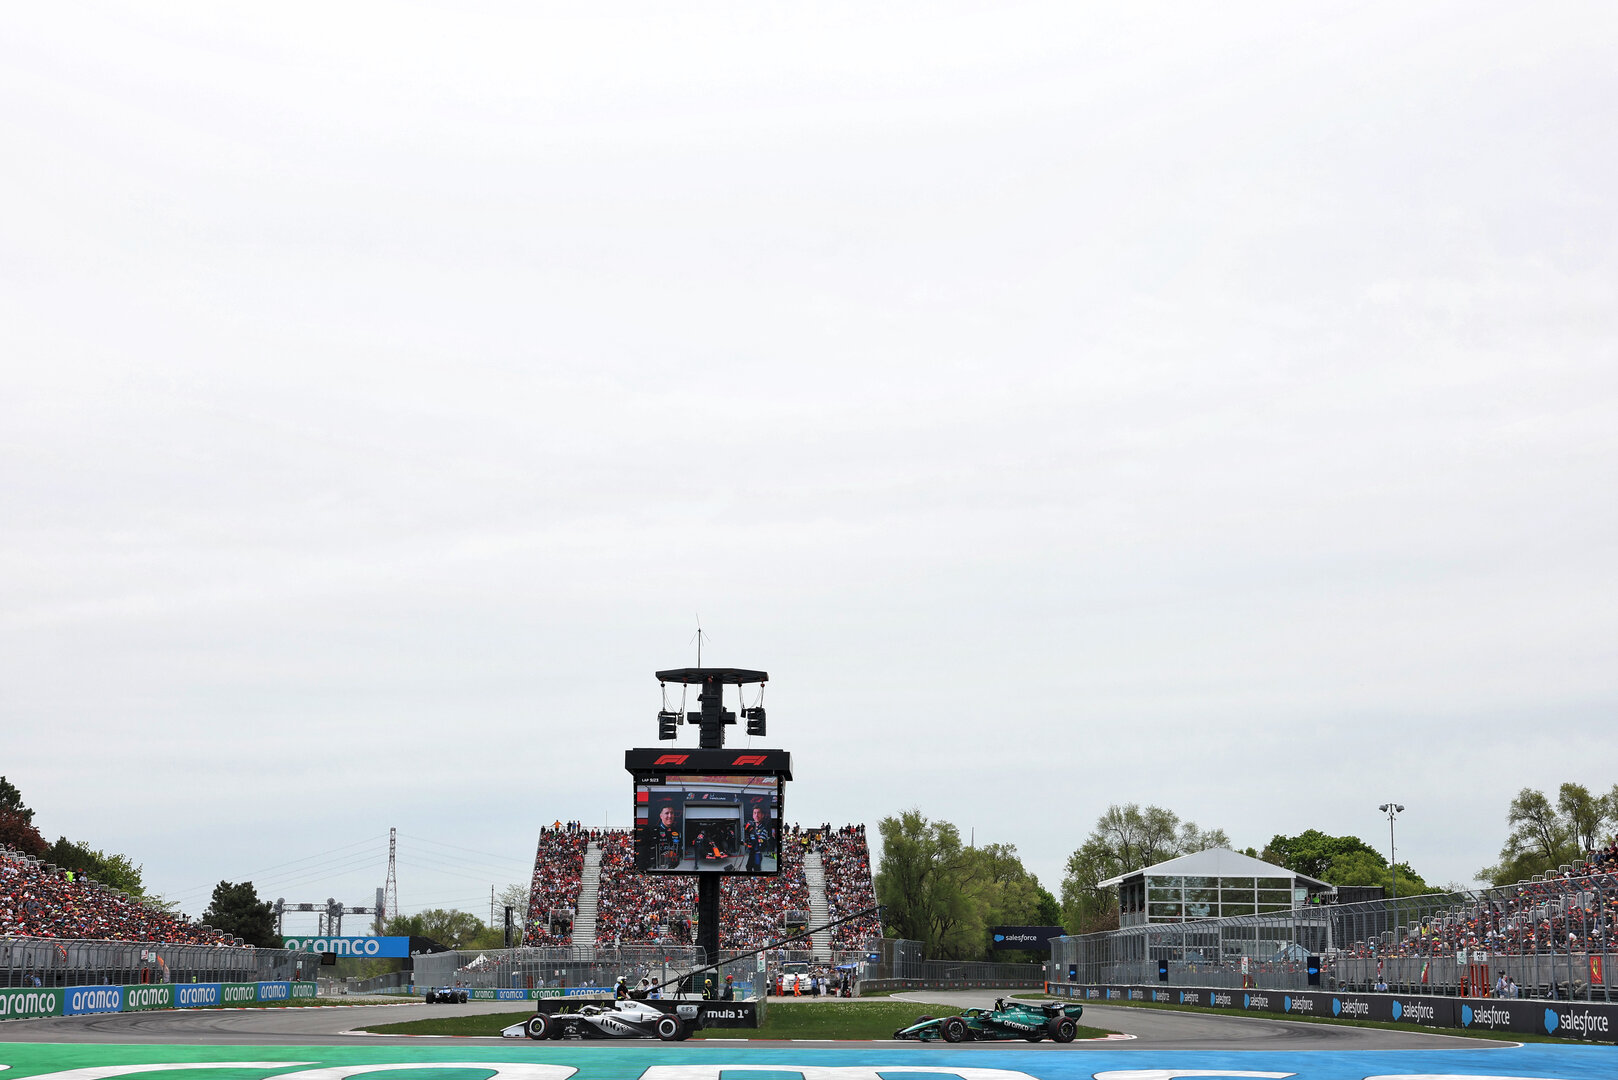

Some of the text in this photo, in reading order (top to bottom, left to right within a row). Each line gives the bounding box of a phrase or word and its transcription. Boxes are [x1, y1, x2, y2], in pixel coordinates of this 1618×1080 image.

[1005, 934, 1037, 943] salesforce
[129, 988, 169, 1007] aramco
[180, 987, 216, 1004] aramco
[224, 986, 255, 1001] aramco
[261, 985, 287, 999] aramco
[292, 984, 314, 997] aramco
[474, 989, 494, 999] aramco
[499, 989, 524, 999] aramco
[531, 989, 561, 999] aramco
[0, 993, 56, 1015] aramco
[72, 990, 119, 1011] aramco
[1216, 992, 1232, 1008] salesforce
[1250, 993, 1269, 1010] salesforce
[1291, 995, 1313, 1014] salesforce
[1341, 998, 1369, 1018] salesforce
[706, 1009, 736, 1019] mula
[1402, 1001, 1434, 1022] salesforce
[1473, 1005, 1510, 1029] salesforce
[1003, 1020, 1029, 1032] aramco
[1560, 1009, 1609, 1037] salesforce
